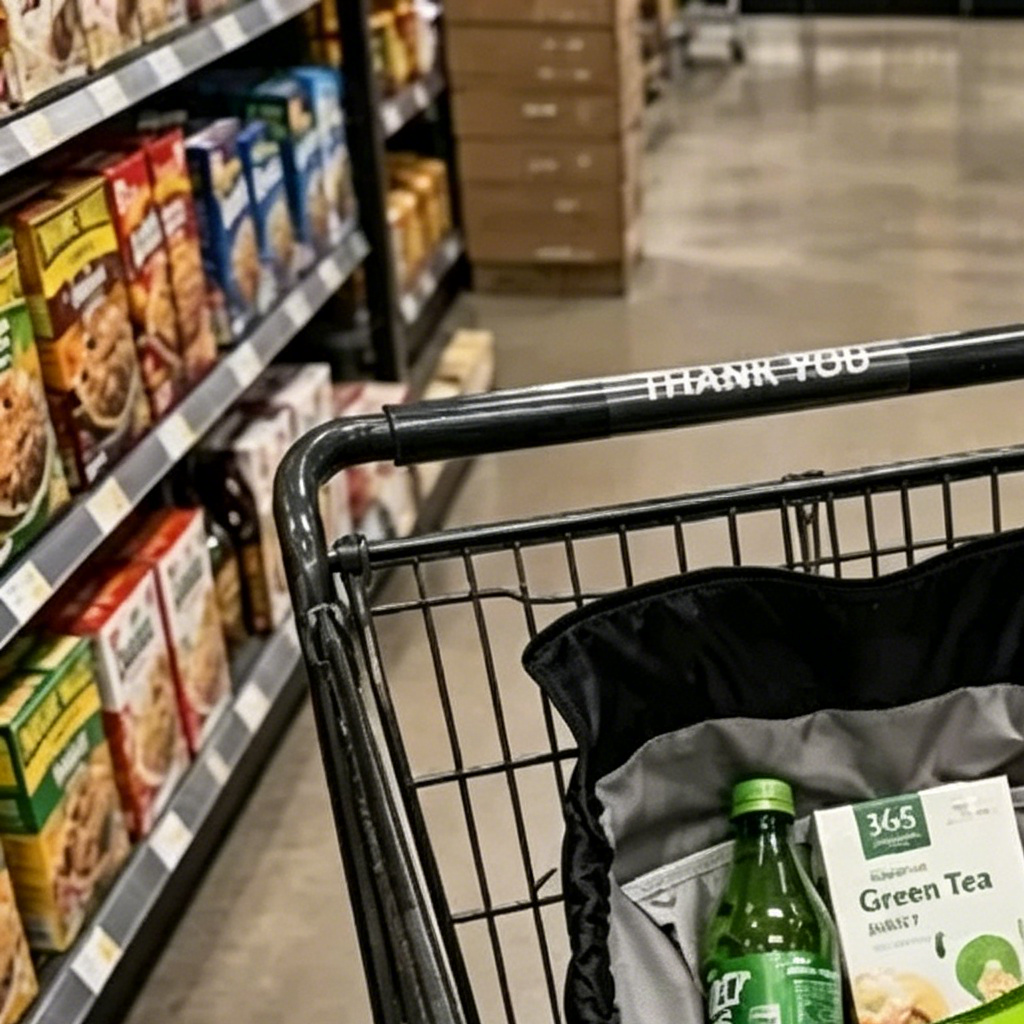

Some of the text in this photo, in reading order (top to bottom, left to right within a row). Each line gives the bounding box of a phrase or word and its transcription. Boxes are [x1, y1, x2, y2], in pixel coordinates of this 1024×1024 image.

[647, 346, 870, 400] THANK YOU
[866, 804, 916, 837] 365
[859, 882, 941, 913] Green
[944, 871, 993, 895] Tea
